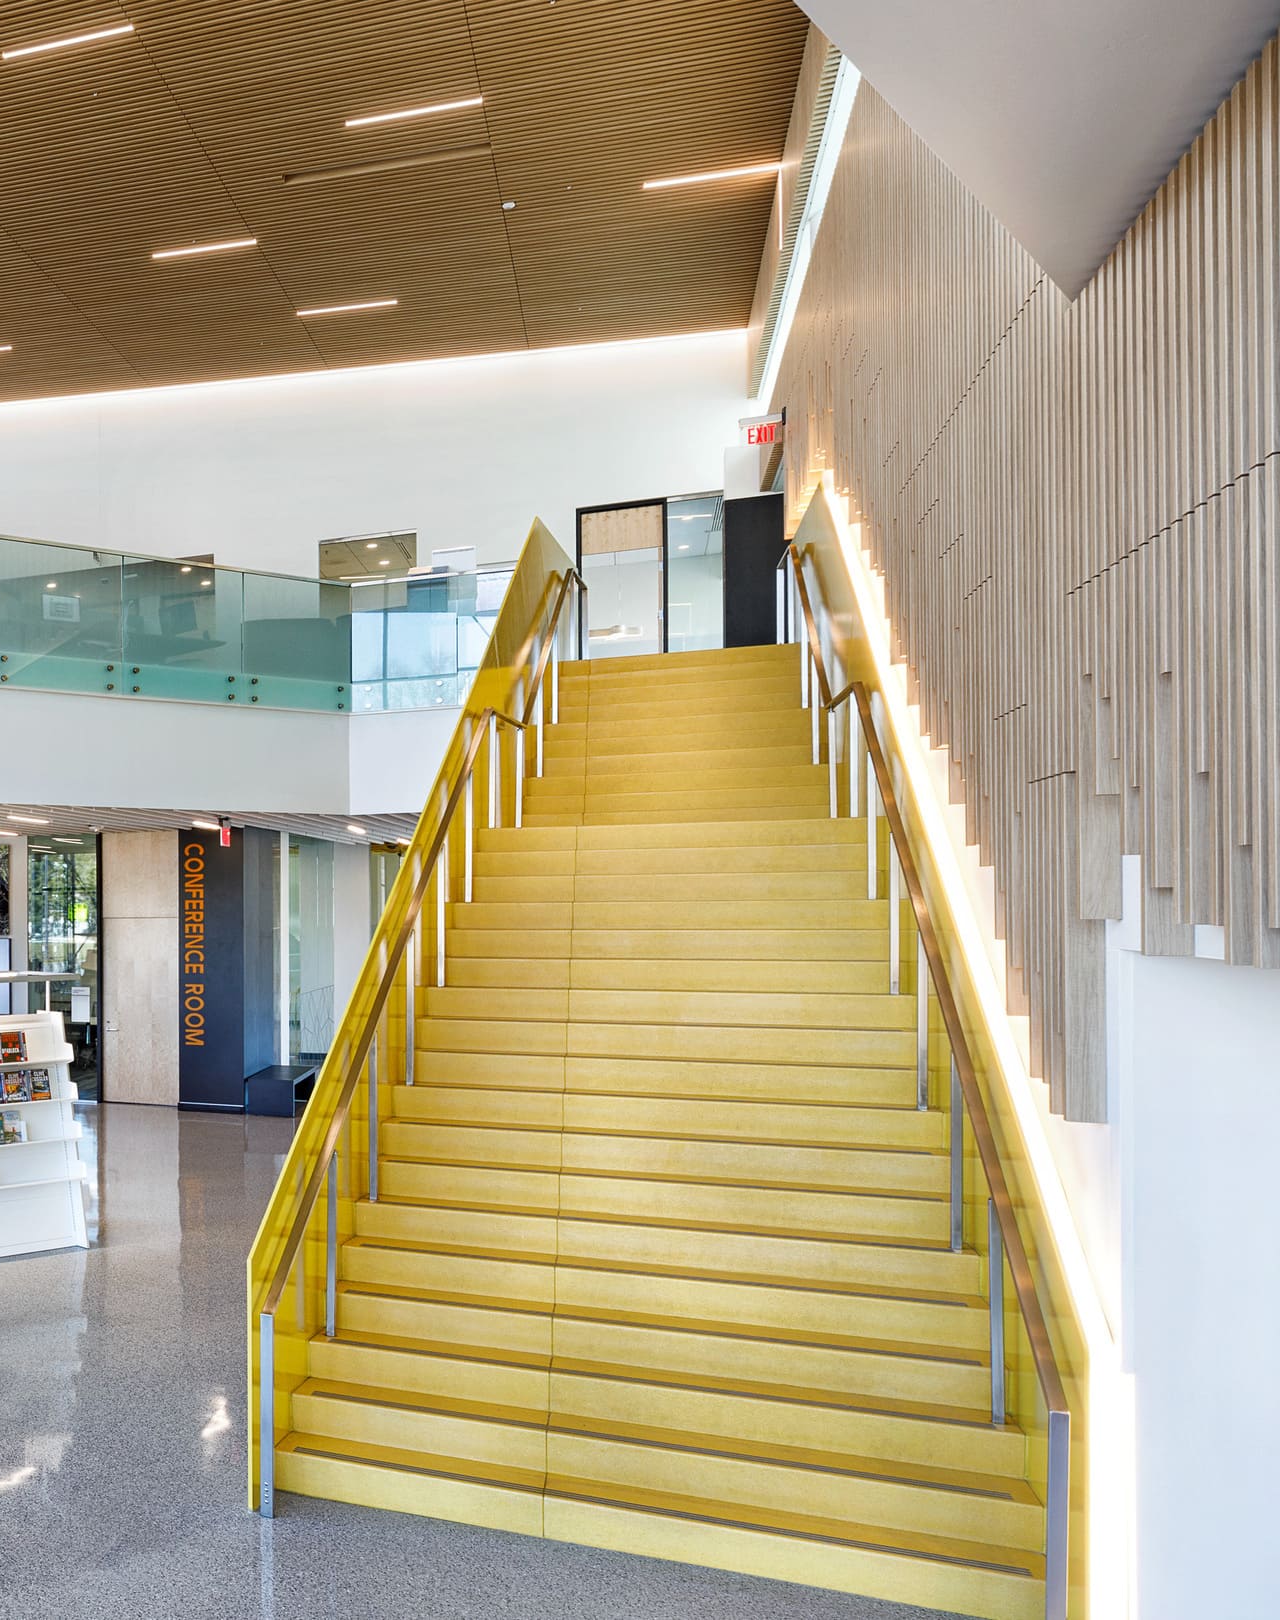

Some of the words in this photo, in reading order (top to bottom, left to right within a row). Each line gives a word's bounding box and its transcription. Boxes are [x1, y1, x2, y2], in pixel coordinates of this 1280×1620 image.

[747, 424, 777, 445] EXIT
[184, 843, 205, 974] CONFERENCE
[184, 983, 205, 1047] ROOM
